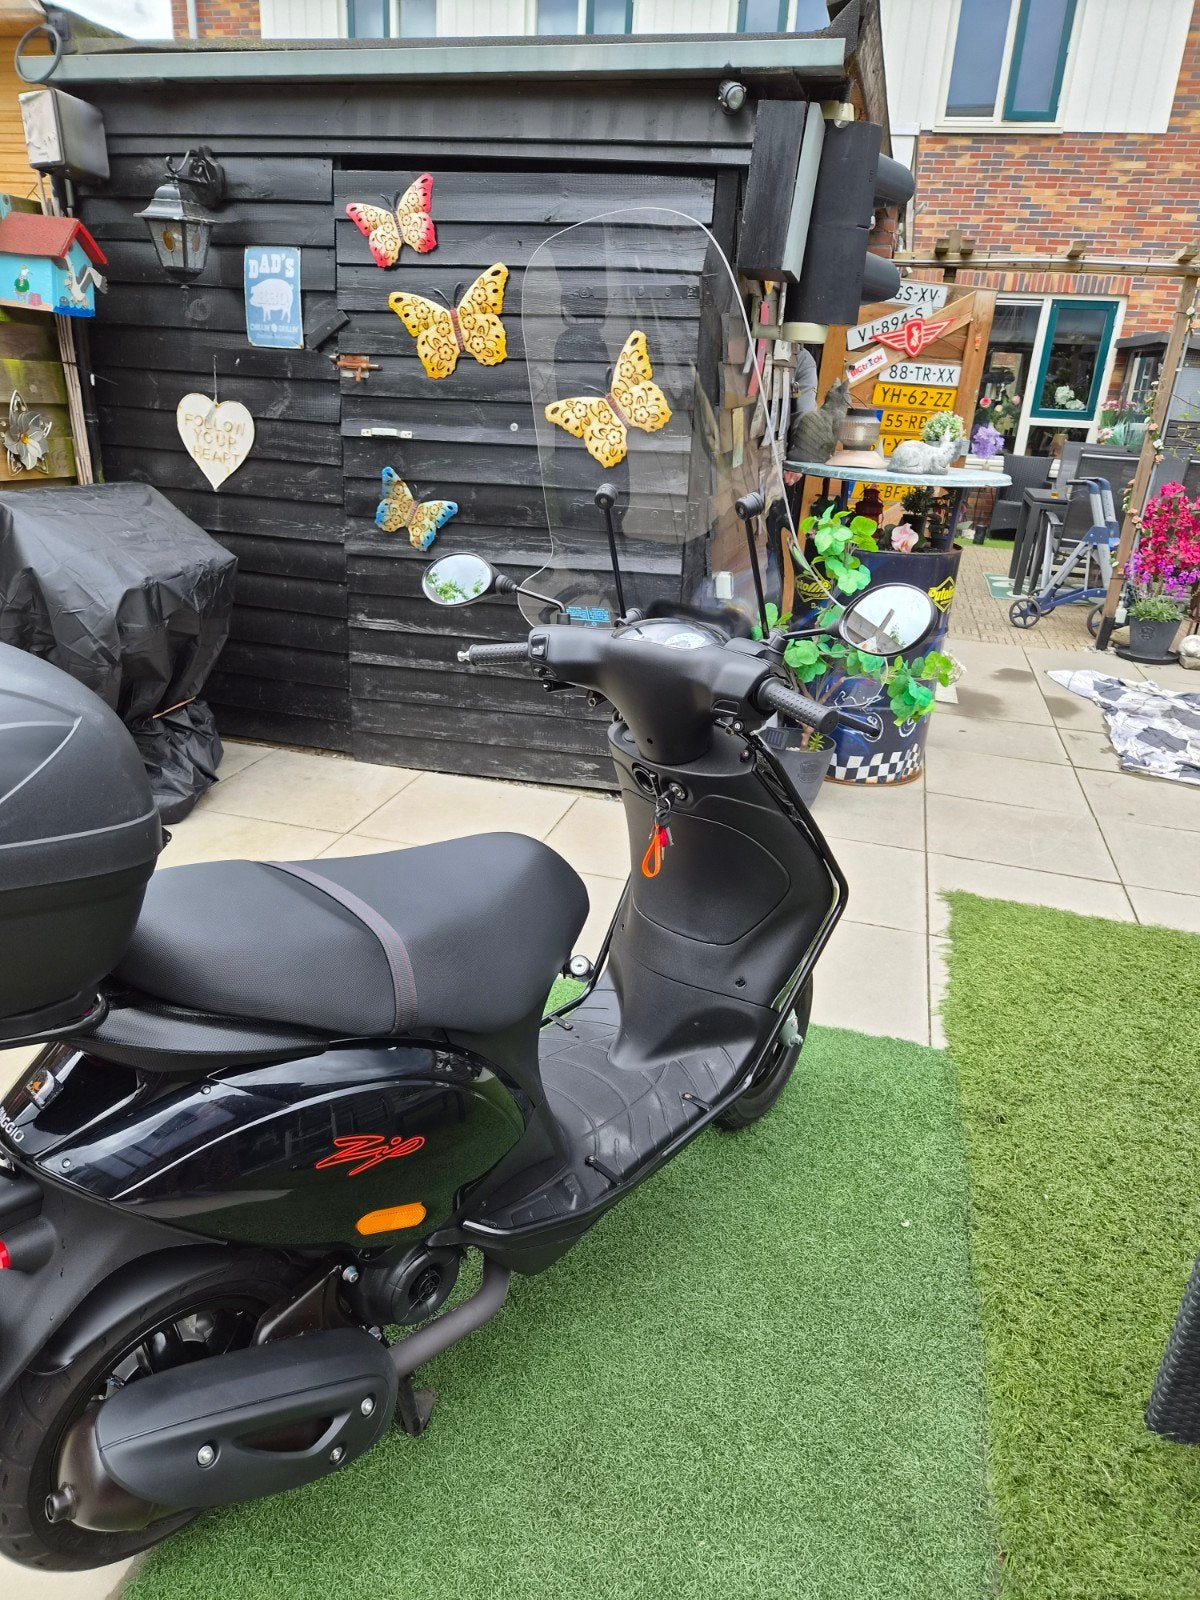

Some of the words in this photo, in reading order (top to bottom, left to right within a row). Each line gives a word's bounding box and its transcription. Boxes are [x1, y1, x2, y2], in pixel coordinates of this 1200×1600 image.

[248, 253, 295, 279] DAD'S
[889, 364, 957, 383] 88-TR-XX
[881, 386, 953, 408] YH-62-ZZ
[184, 413, 246, 436] FOLLOW
[193, 445, 240, 467] HEART
[315, 1133, 425, 1177] Zip
